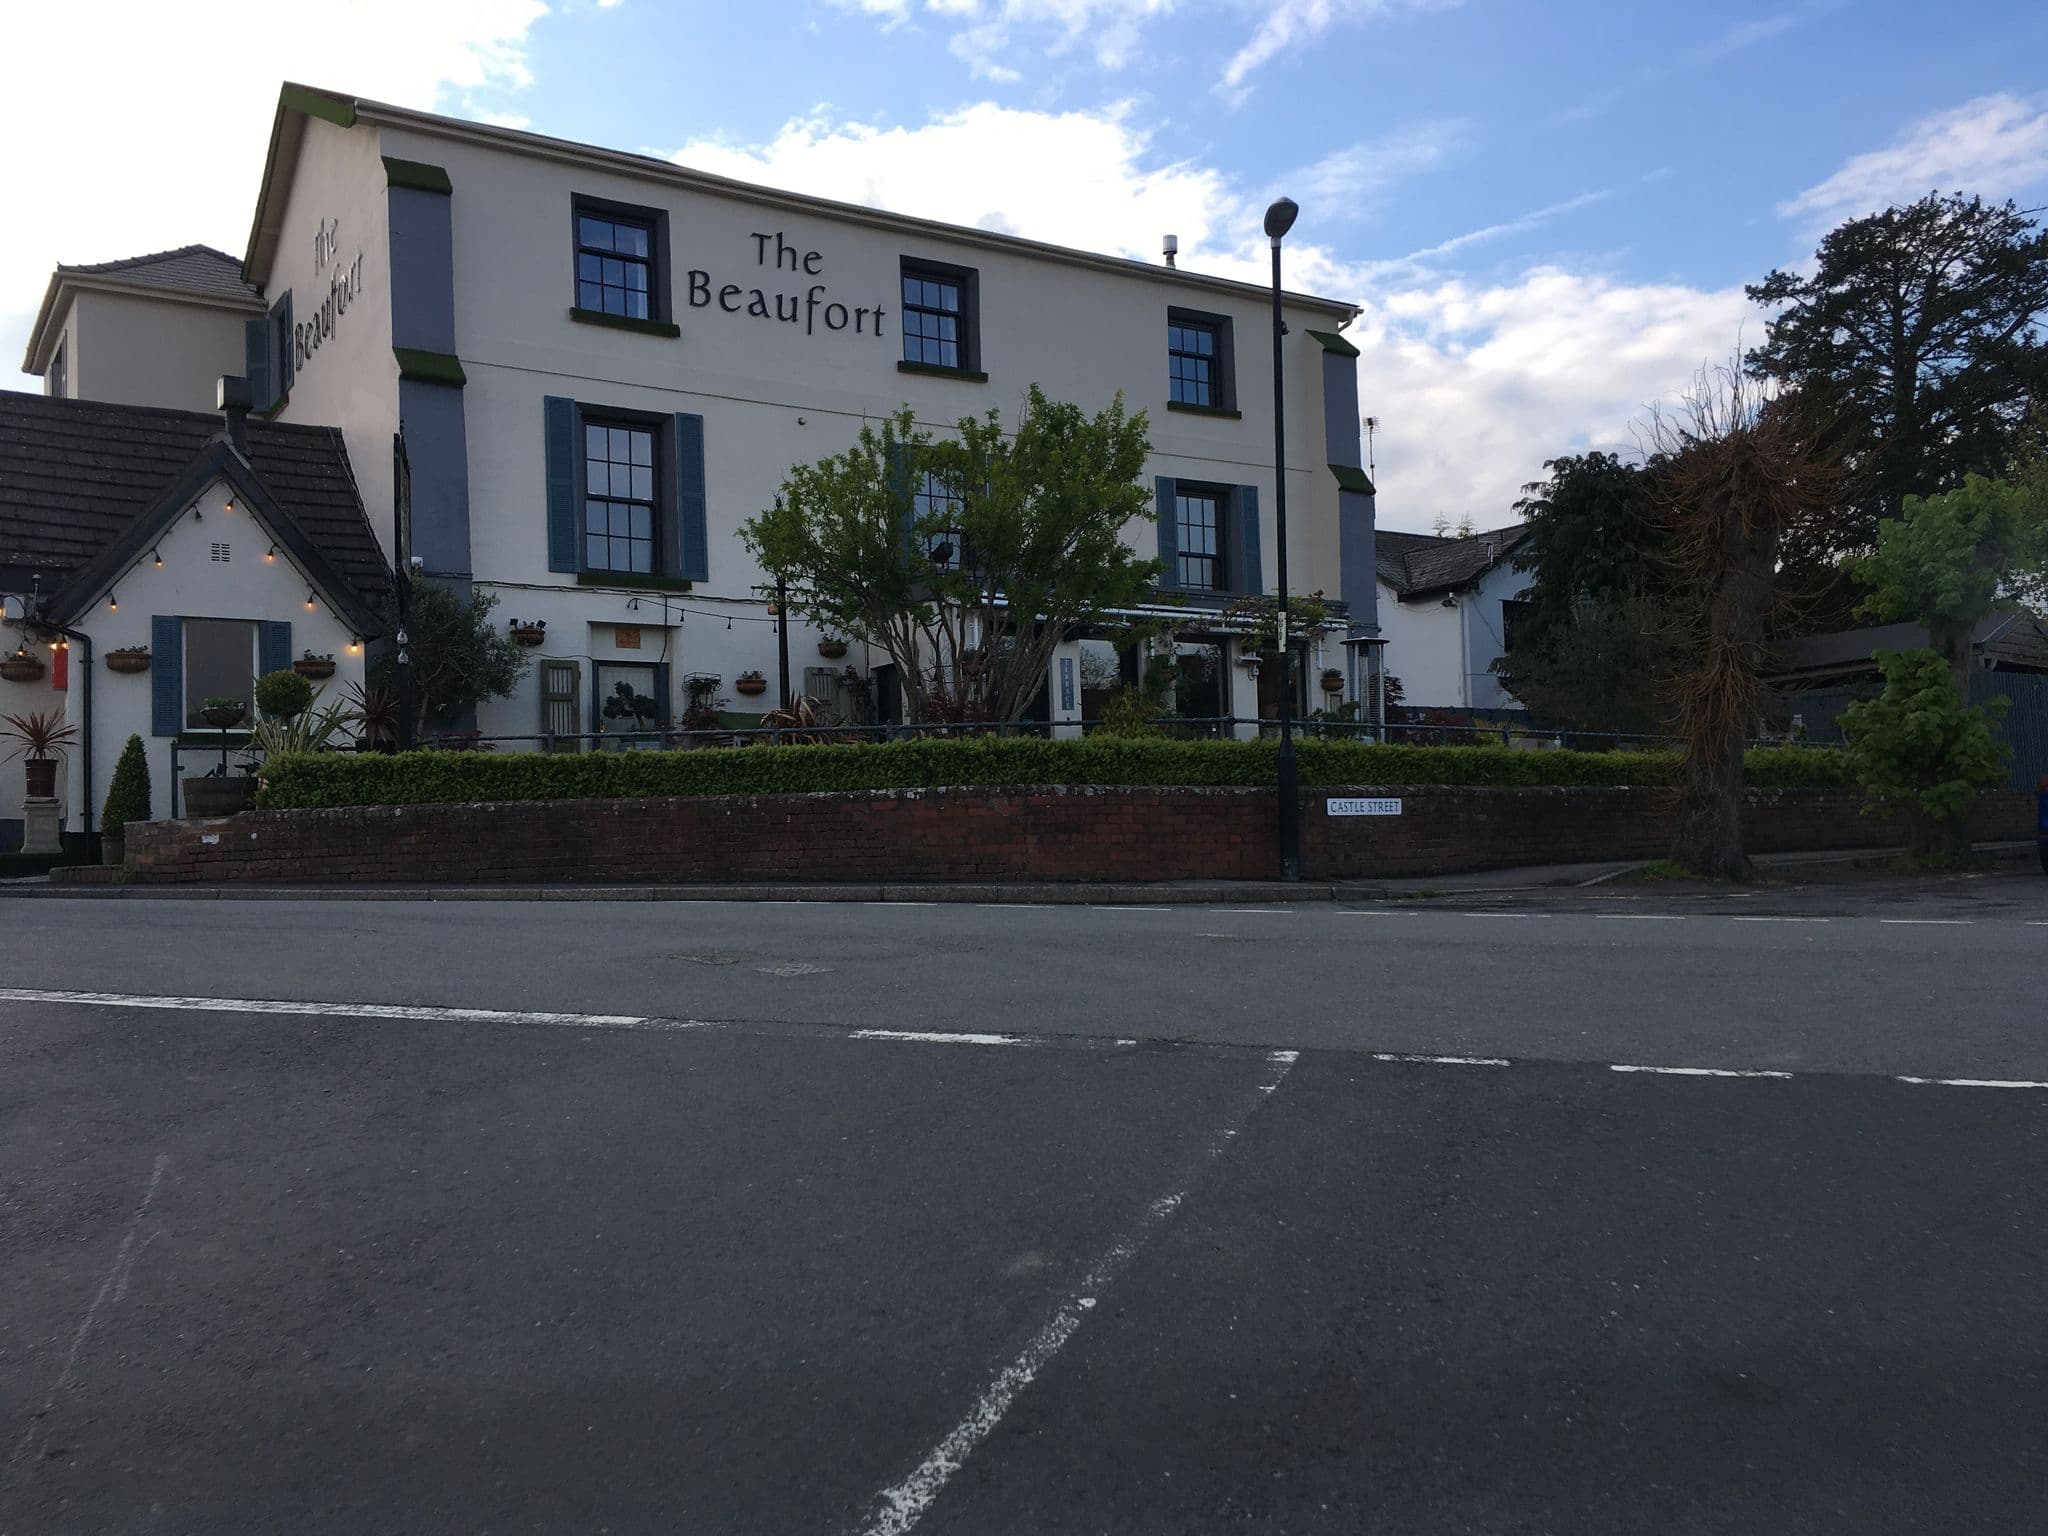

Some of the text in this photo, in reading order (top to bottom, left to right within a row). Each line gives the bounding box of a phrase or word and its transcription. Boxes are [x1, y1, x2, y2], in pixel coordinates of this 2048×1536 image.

[751, 232, 823, 275] The
[295, 244, 364, 373] Beaufort
[688, 269, 886, 337] Beaufort
[1330, 801, 1399, 813] CASTLE STREET
